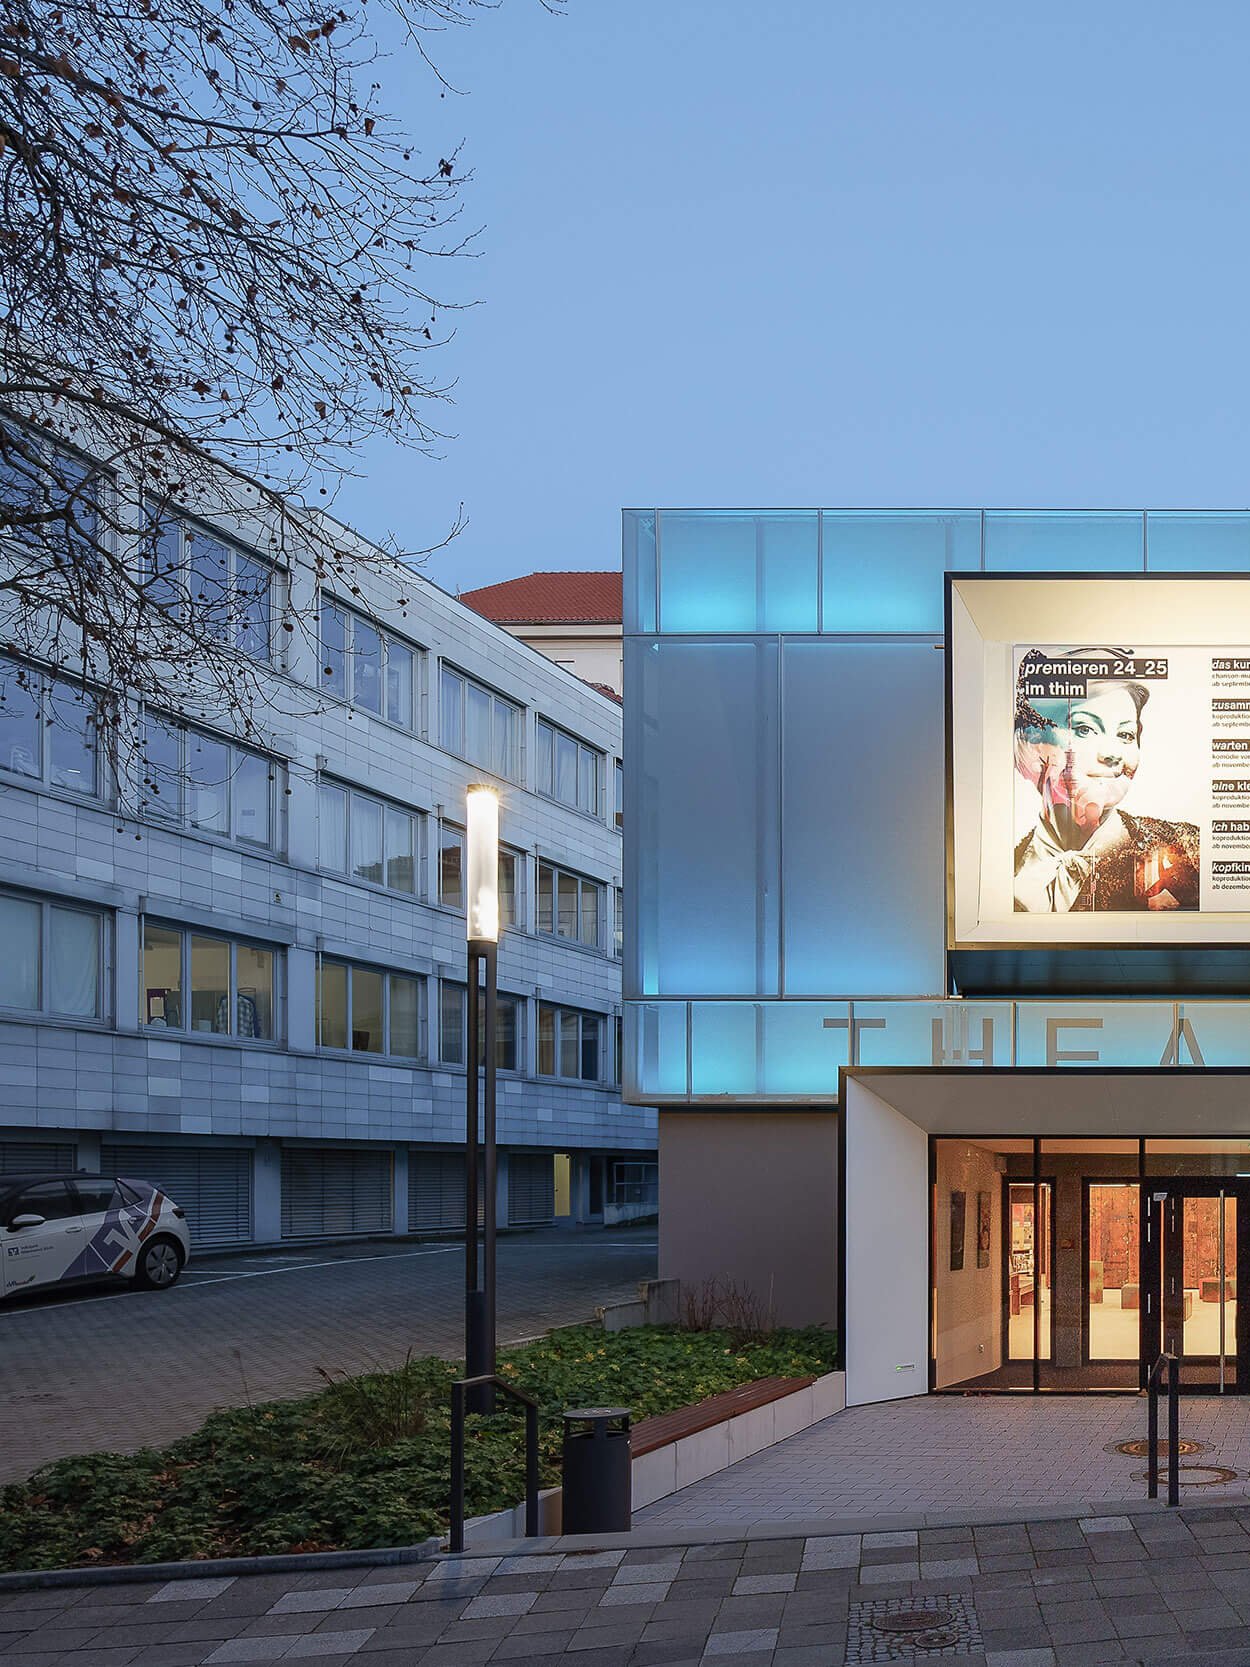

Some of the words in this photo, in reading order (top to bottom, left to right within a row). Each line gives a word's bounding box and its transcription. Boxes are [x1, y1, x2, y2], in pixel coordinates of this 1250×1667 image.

[1025, 661, 1108, 677] premieren
[1114, 661, 1167, 677] 24_25
[1212, 659, 1231, 669] das
[1025, 680, 1045, 695] im
[1049, 680, 1084, 695] thim
[1212, 741, 1248, 750] warten
[1212, 781, 1235, 791] eine
[1212, 822, 1228, 831] ich
[1230, 822, 1250, 831] hab
